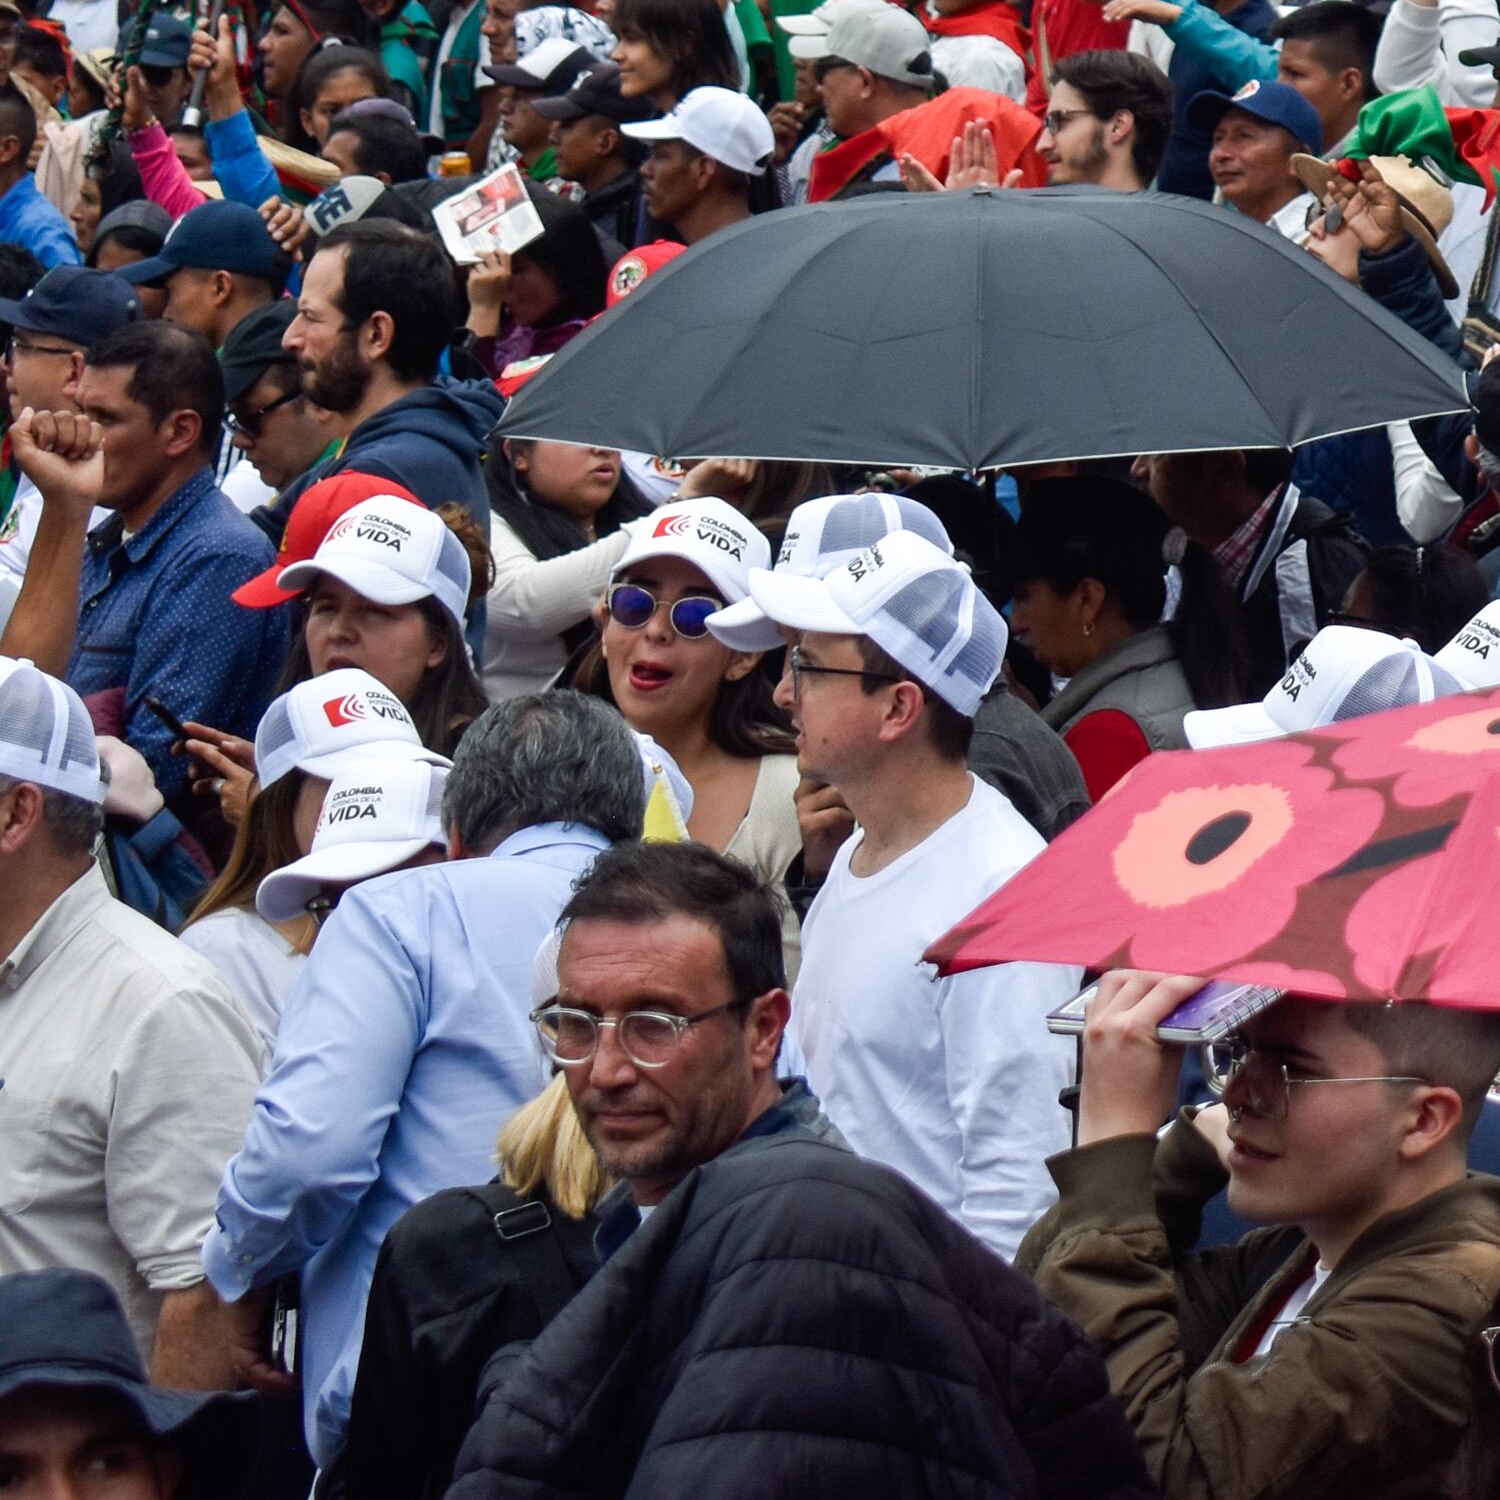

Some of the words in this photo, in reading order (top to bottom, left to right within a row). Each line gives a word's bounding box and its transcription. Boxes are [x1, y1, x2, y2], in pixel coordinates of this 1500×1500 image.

[364, 514, 412, 537] COLOMBIA
[701, 515, 748, 546] COLOMBIA
[356, 527, 401, 552] VIDA
[696, 529, 742, 562] VIDA
[1456, 632, 1490, 660] VIDA
[333, 786, 383, 801] COLOMBIA
[329, 803, 377, 825] VIDA
